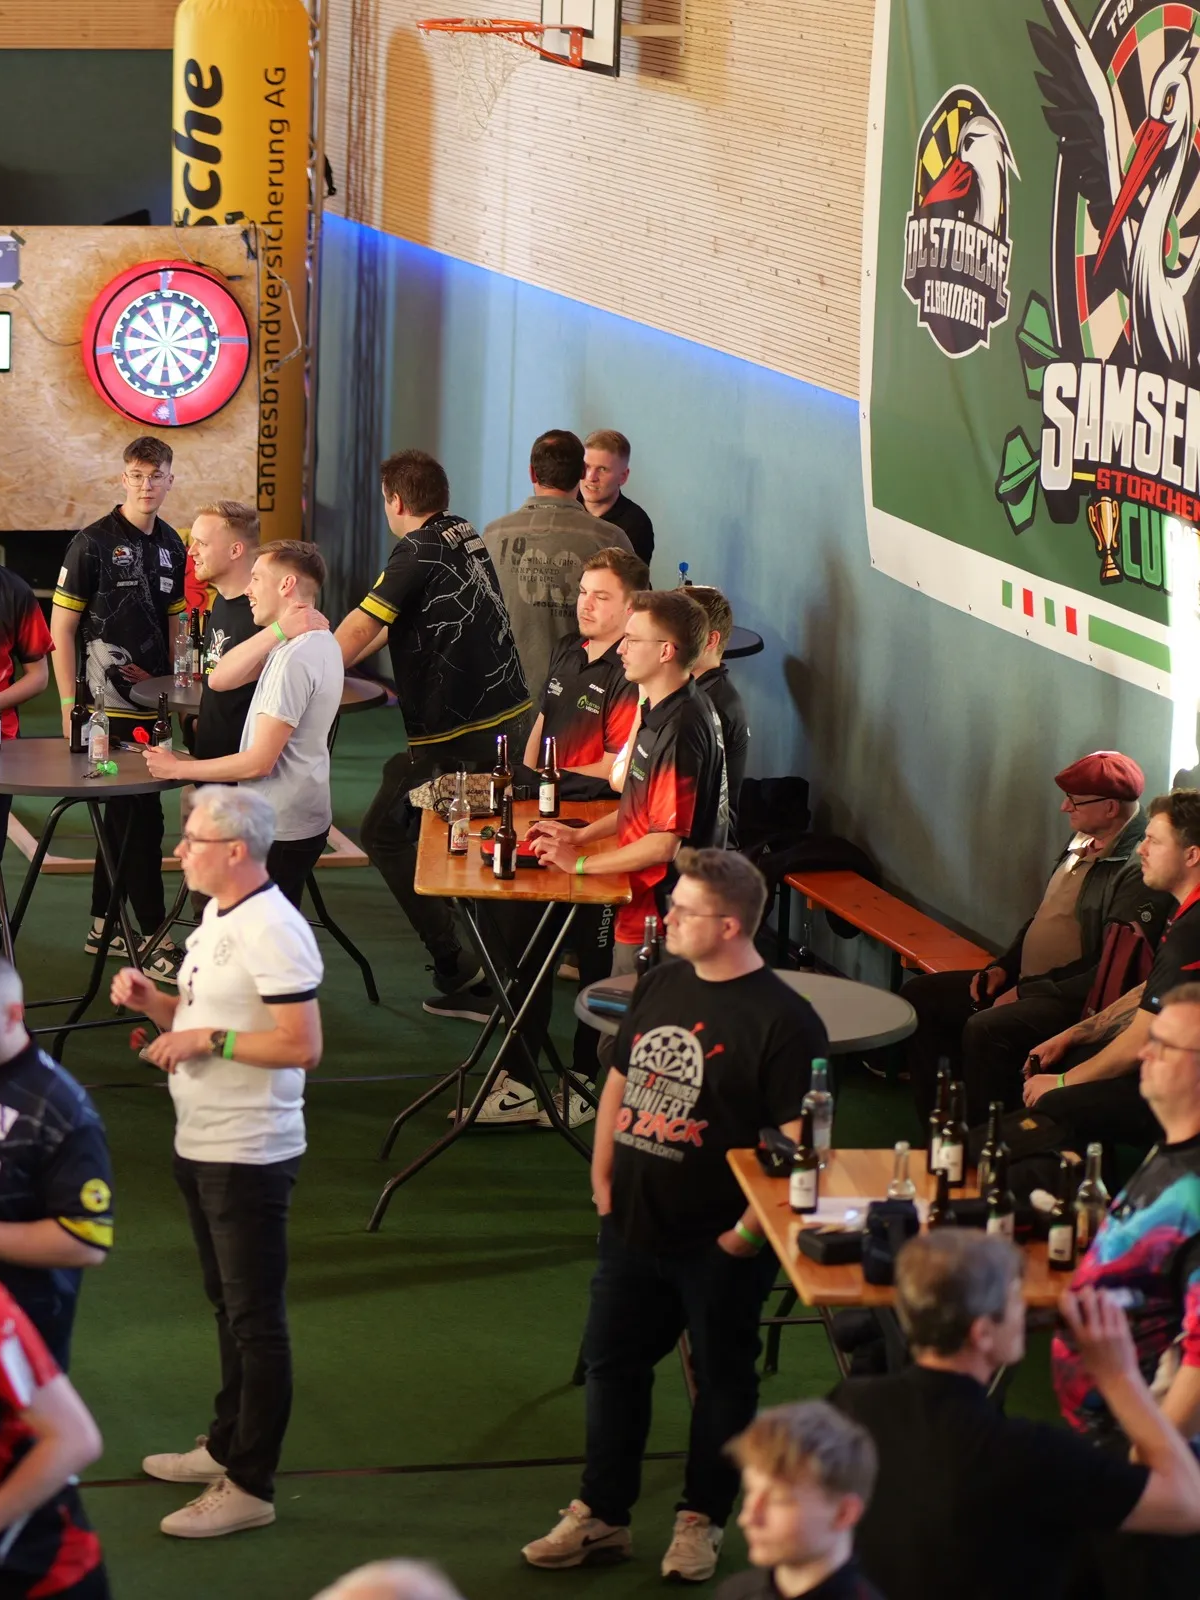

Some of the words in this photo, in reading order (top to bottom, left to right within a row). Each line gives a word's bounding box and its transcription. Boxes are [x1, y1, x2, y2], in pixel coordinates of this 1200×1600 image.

[264, 67, 287, 108] AG
[173, 58, 224, 226] che
[906, 218, 928, 280] DC
[257, 117, 291, 513] Landesbrandversicherung
[924, 279, 986, 330] ELBRINXEN
[623, 1081, 695, 1120] RAINIERT
[632, 1110, 709, 1147] ZACK
